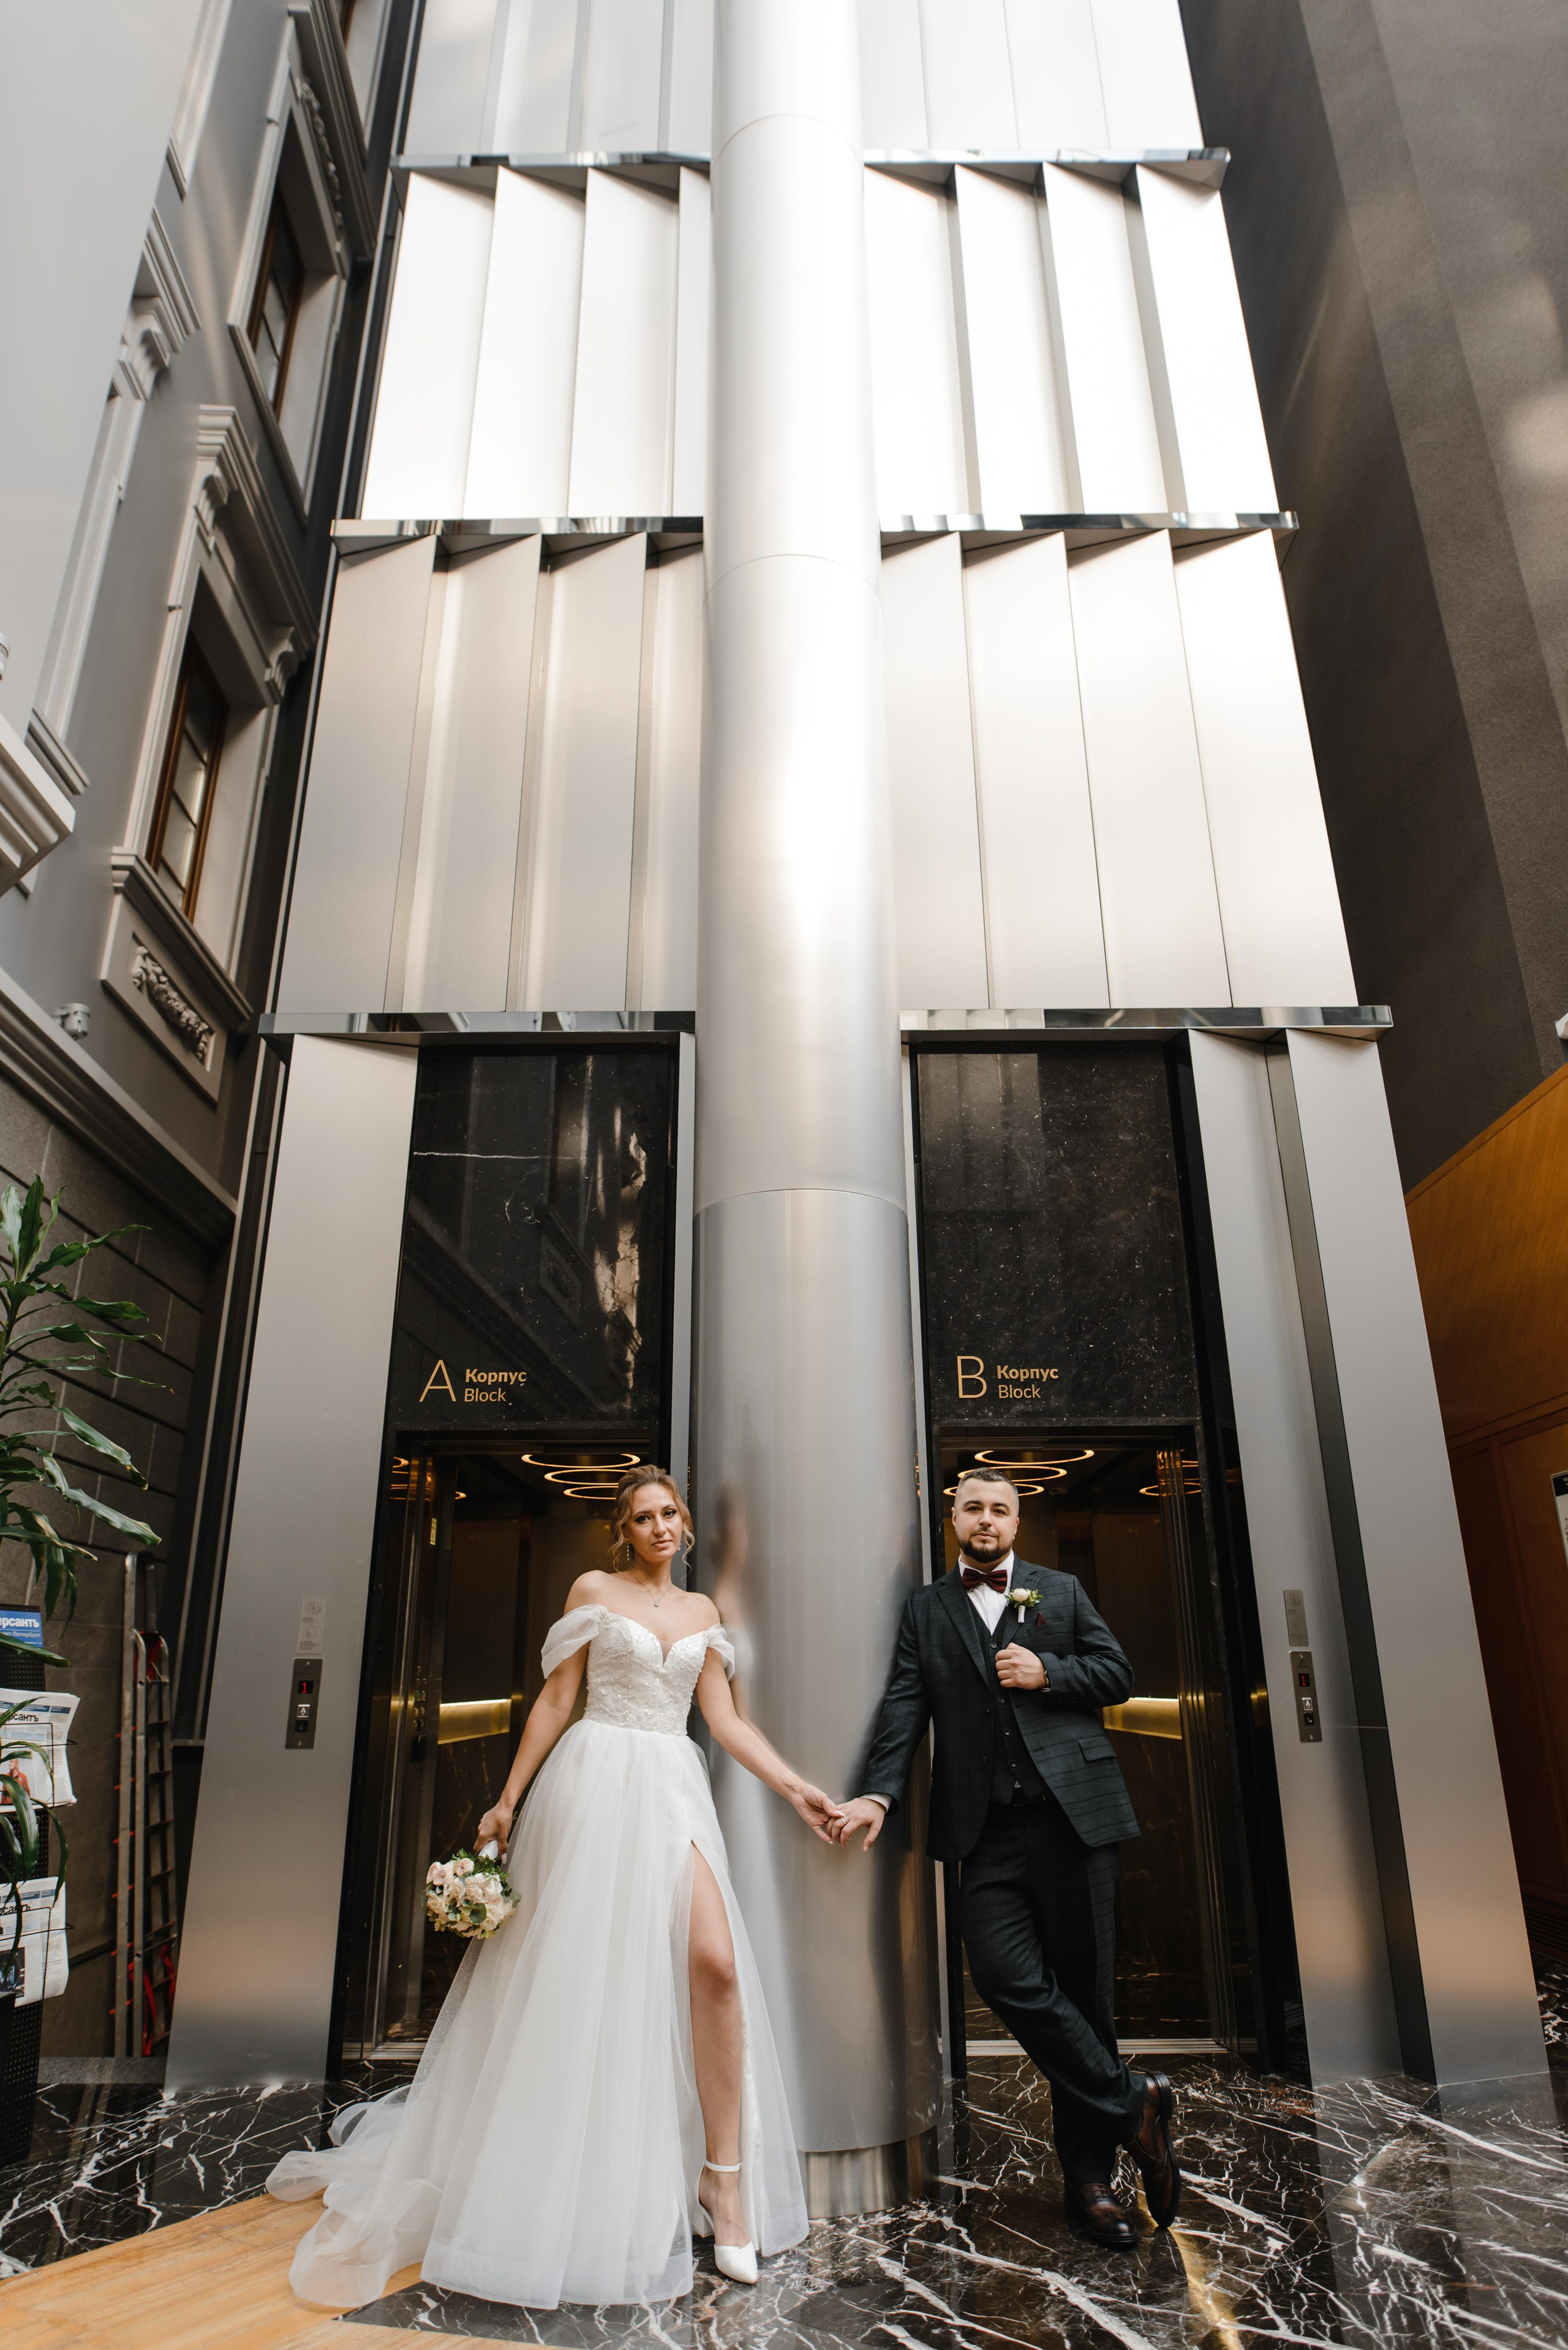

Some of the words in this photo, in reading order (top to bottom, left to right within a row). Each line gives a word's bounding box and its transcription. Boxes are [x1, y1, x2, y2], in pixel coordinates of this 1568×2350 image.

[465, 1368, 527, 1385] Корпус
[997, 1365, 1059, 1382] Корпус
[464, 1387, 507, 1402] Block
[998, 1384, 1041, 1398] Block
[302, 1682, 307, 1693] 1
[1301, 1675, 1306, 1686] 1
